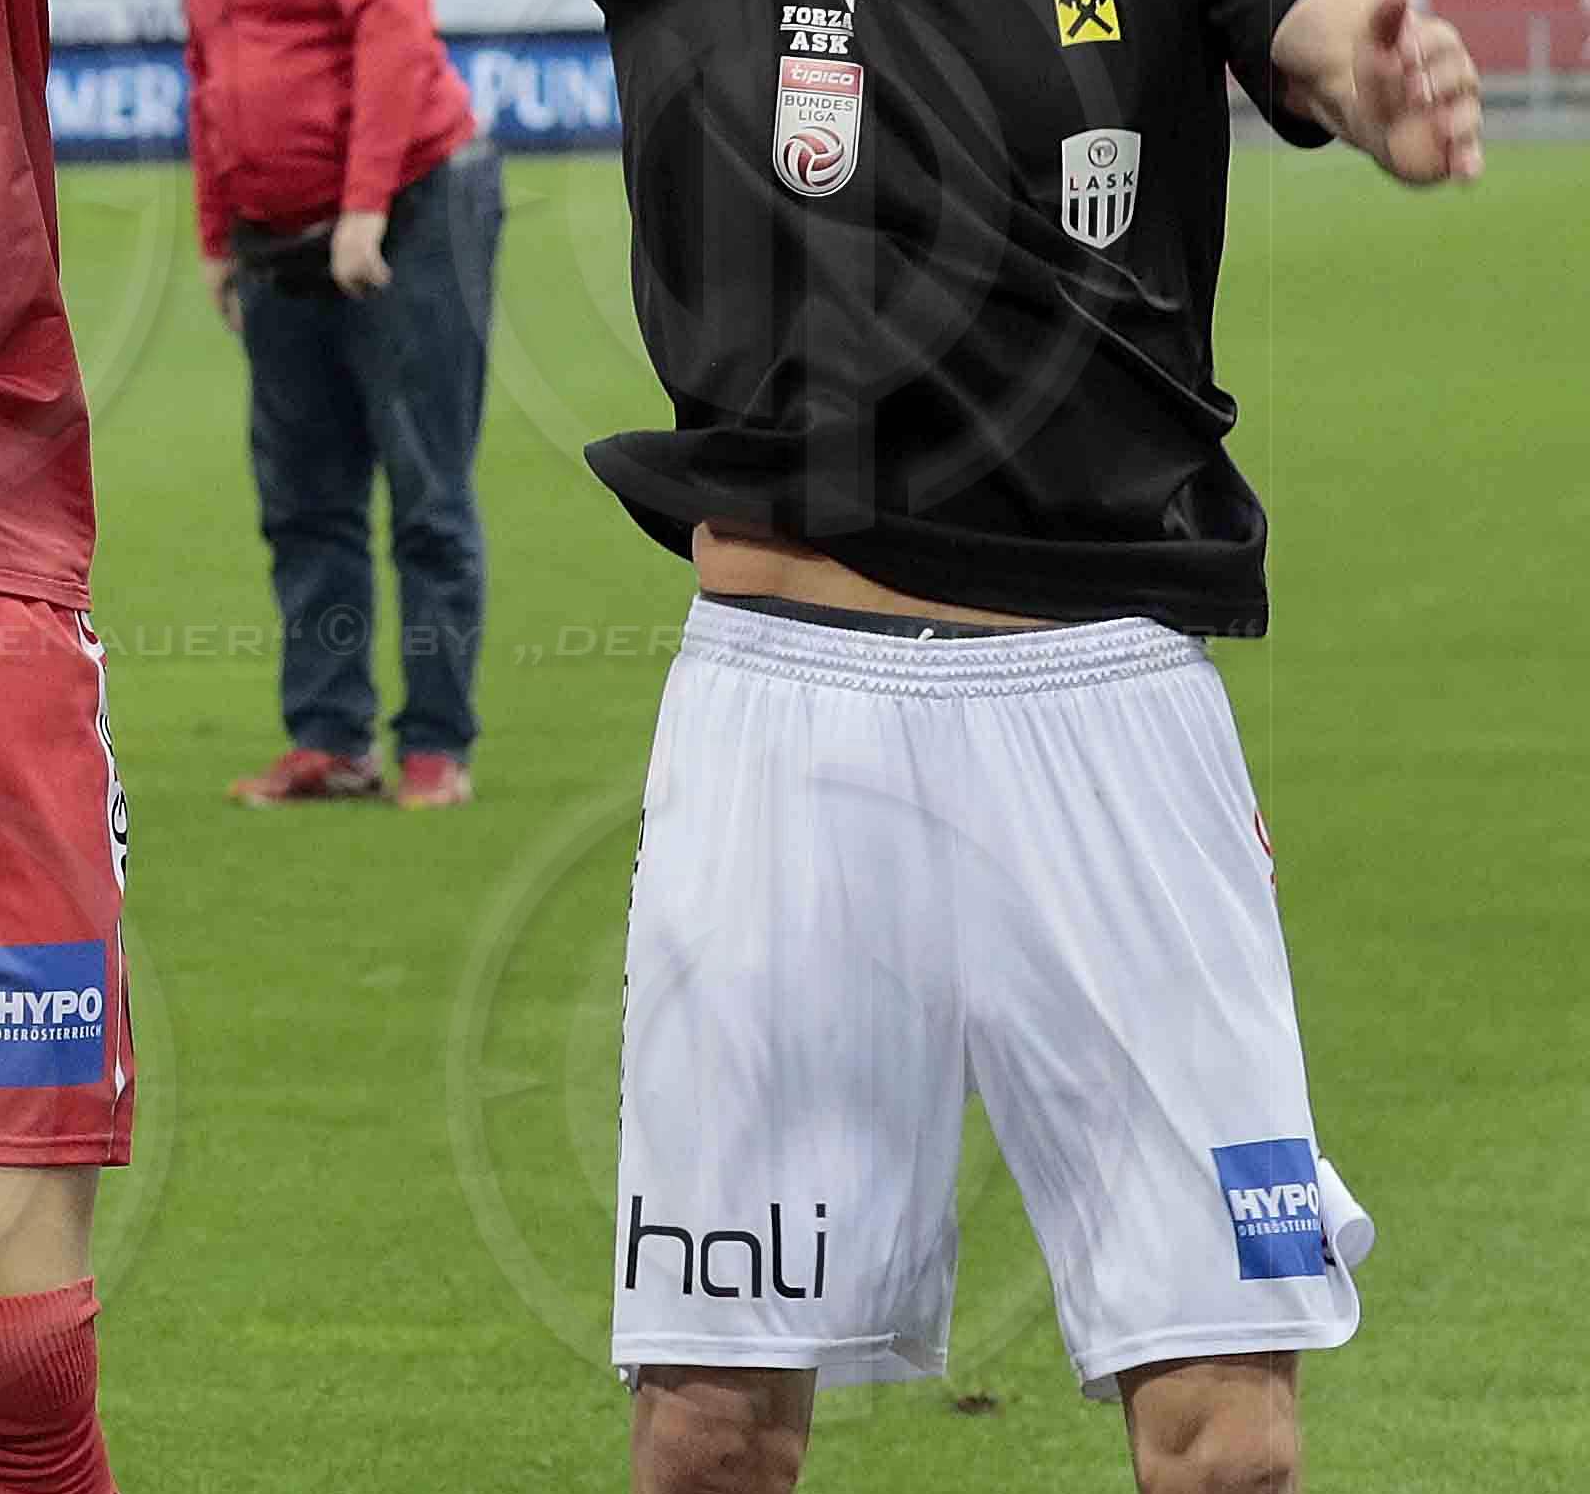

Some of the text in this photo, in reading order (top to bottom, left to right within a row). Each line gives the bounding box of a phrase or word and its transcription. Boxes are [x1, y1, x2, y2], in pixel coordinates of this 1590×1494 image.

[781, 5, 855, 28] FORZA
[789, 31, 849, 55] ASK
[789, 64, 855, 87] tipico
[784, 94, 855, 112] BUNDES
[798, 110, 837, 124] LIGA
[1069, 170, 1135, 192] LASK
[1229, 1181, 1319, 1221] HYPO
[625, 1194, 827, 1299] hali
